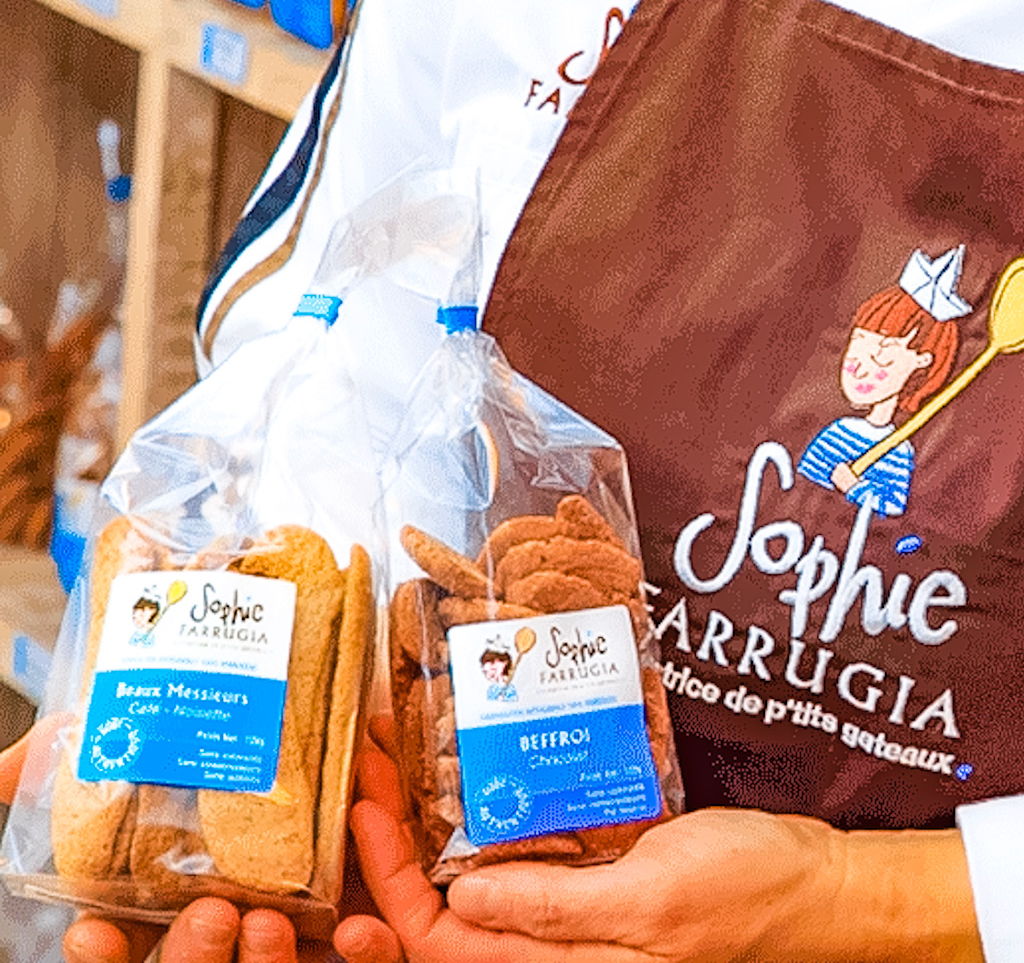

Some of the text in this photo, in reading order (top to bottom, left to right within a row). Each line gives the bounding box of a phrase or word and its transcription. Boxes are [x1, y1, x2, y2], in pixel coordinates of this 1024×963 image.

[673, 440, 968, 646] Sophie
[190, 582, 265, 625] Sophie
[179, 624, 269, 645] FARRUGIA
[545, 626, 608, 669] Sophie
[540, 662, 620, 685] FARRUGIA
[116, 682, 249, 705] Beaux Messieurs
[723, 685, 764, 716] de
